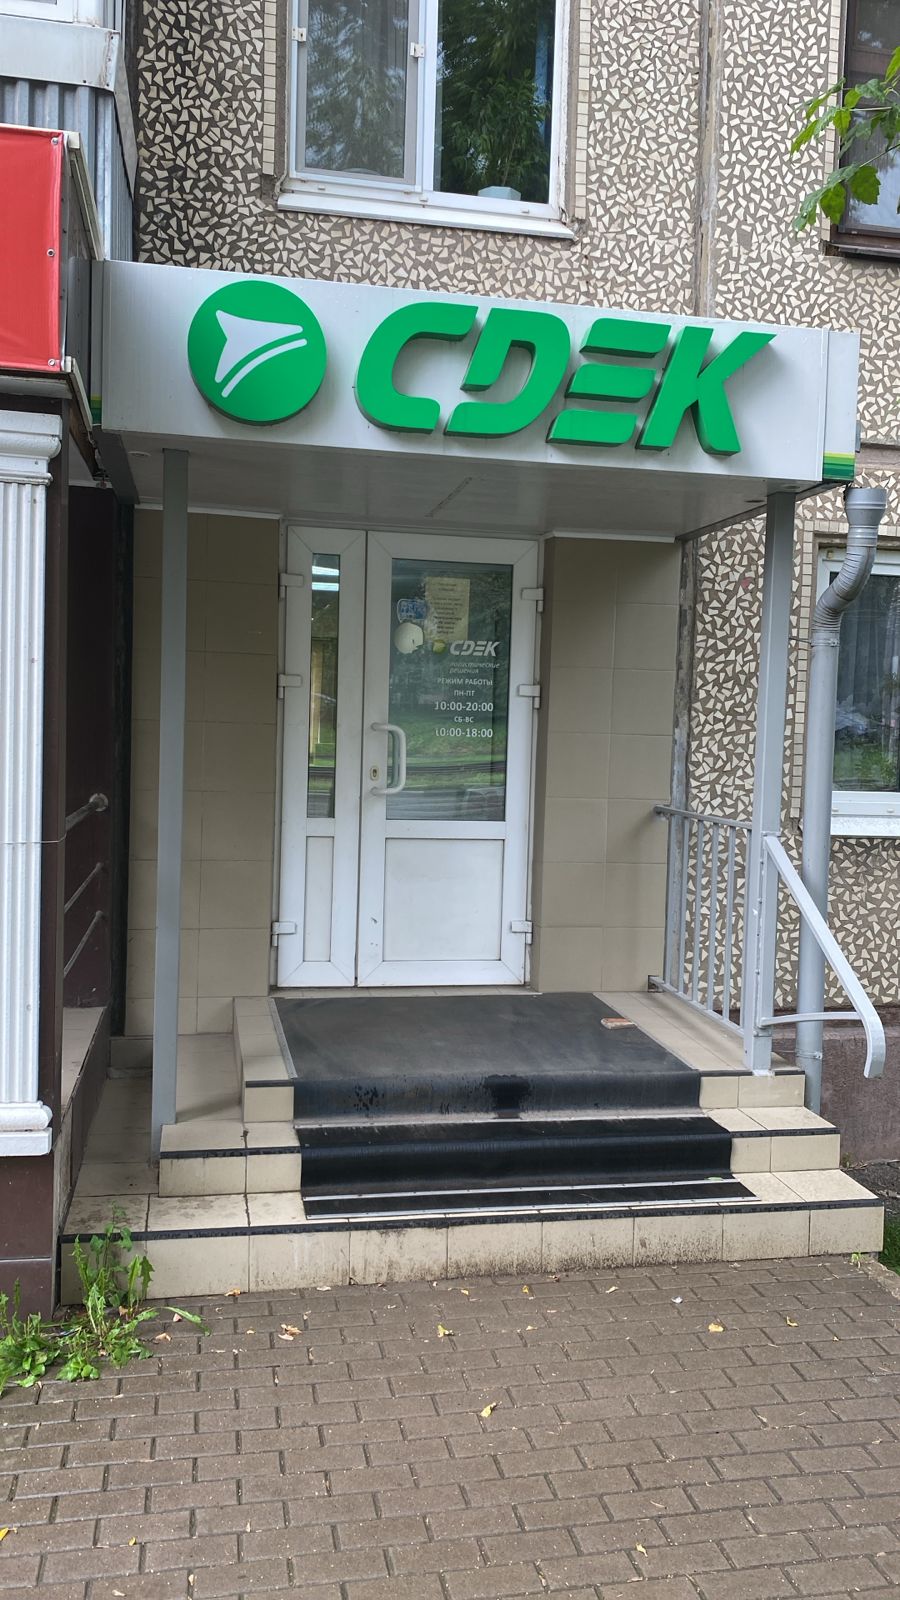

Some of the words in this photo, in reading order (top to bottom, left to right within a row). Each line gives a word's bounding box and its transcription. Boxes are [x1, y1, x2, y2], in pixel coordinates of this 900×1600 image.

[355, 302, 776, 456] CDEK
[450, 640, 500, 656] CDEK
[465, 678, 493, 686] РАБОТЫ
[434, 701, 493, 712] 10:00-20:00
